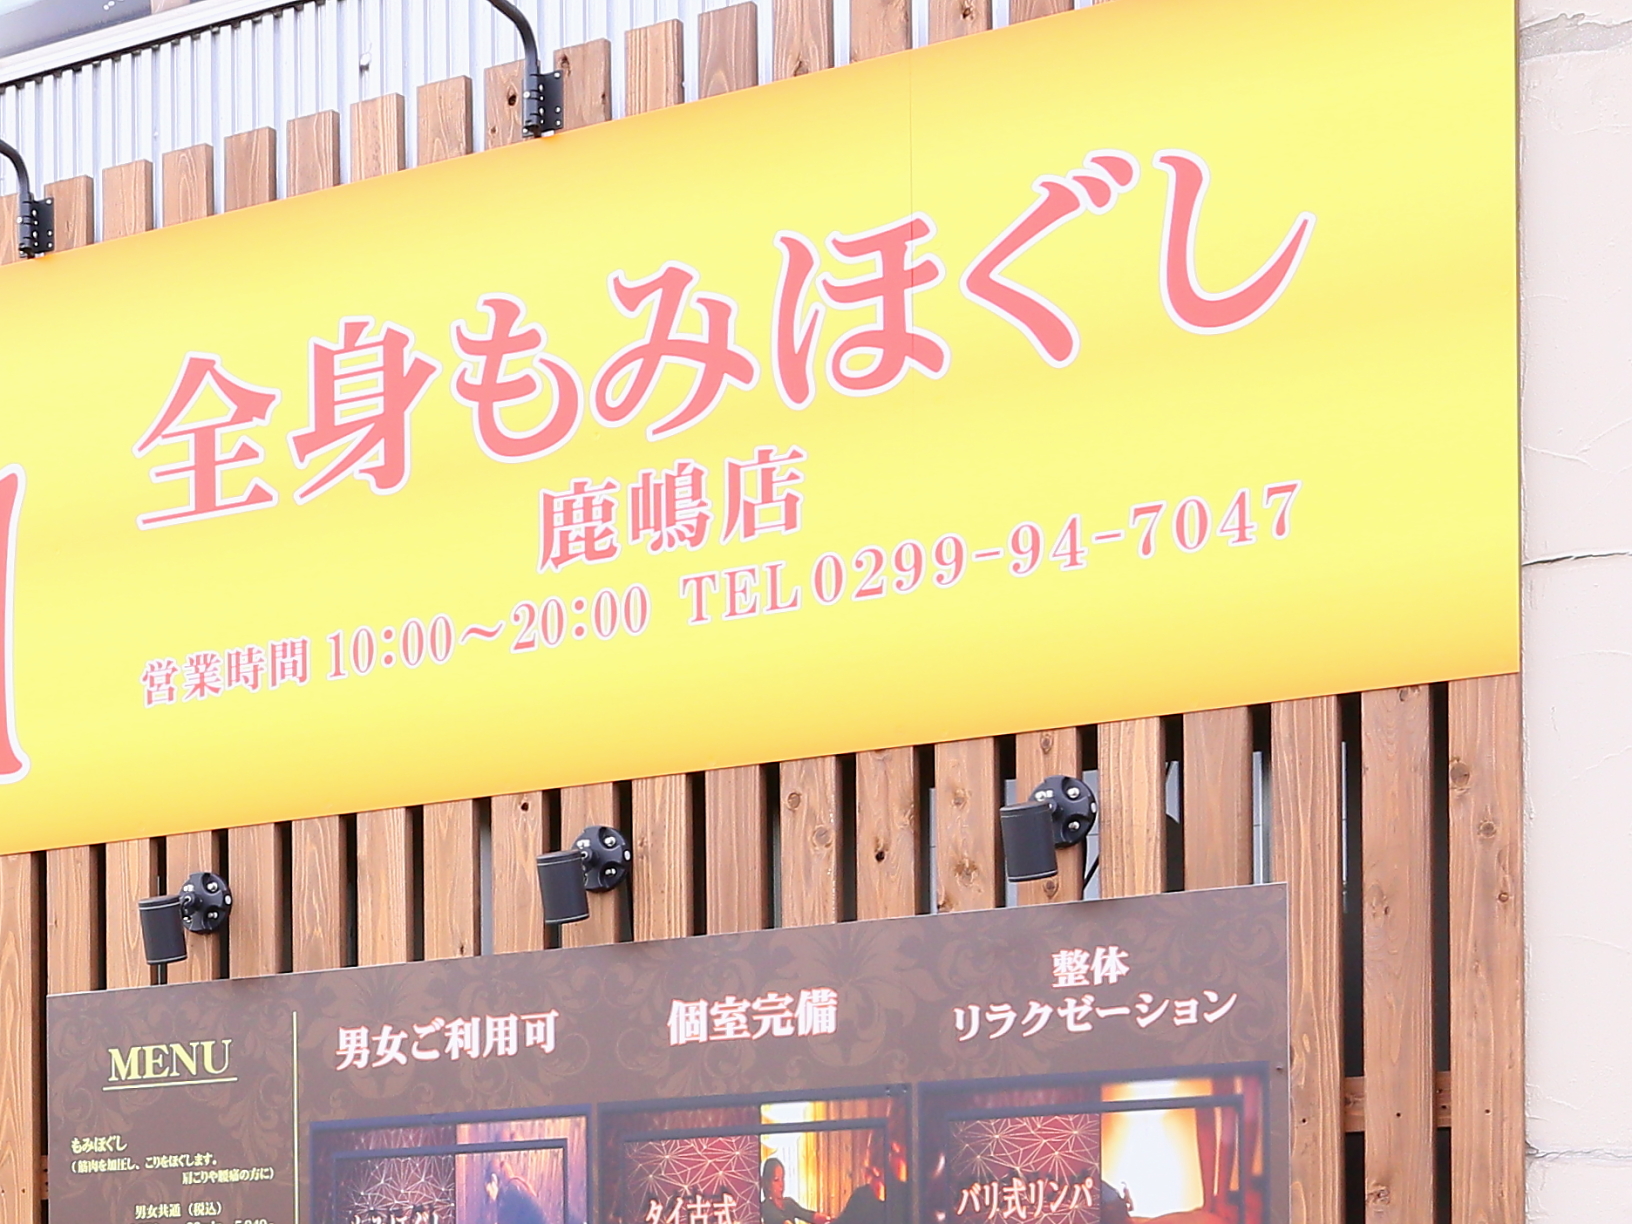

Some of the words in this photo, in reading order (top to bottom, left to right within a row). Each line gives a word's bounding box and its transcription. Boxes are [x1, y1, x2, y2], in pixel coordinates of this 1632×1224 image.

[131, 148, 1316, 532] 全身もみほぐし
[536, 445, 808, 572] 鹿嶋店
[140, 637, 308, 709] 営業時間
[1051, 946, 1130, 988] 整体
[336, 1009, 559, 1071] 男女ご利用可
[666, 988, 838, 1046] 個室完備
[953, 982, 1237, 1042] リラクゼーション
[108, 1039, 232, 1082] MENU
[71, 1135, 128, 1154] もみほぐし
[955, 1177, 1094, 1220] バリ式リンパ
